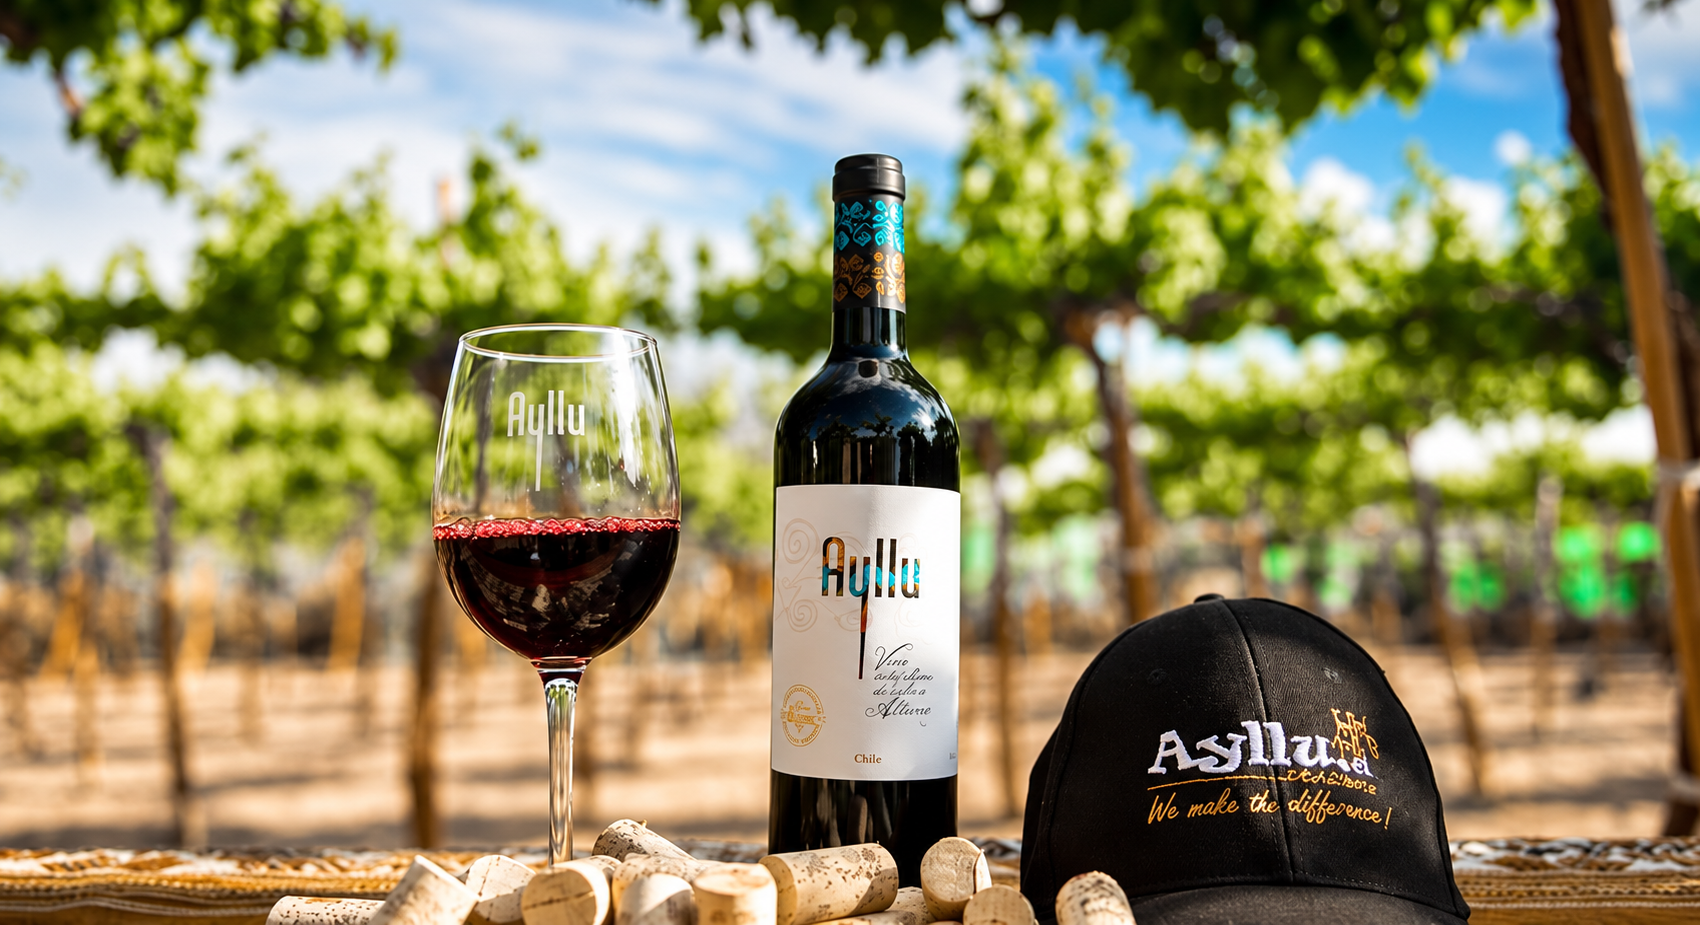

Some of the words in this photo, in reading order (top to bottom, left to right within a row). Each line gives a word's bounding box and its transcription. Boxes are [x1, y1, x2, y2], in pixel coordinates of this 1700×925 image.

[507, 389, 585, 492] Ayllu
[821, 536, 921, 680] Ayllu
[854, 752, 882, 764] Chile
[1147, 791, 1179, 824] We
[1187, 788, 1240, 819] make
[1249, 789, 1281, 814] the
